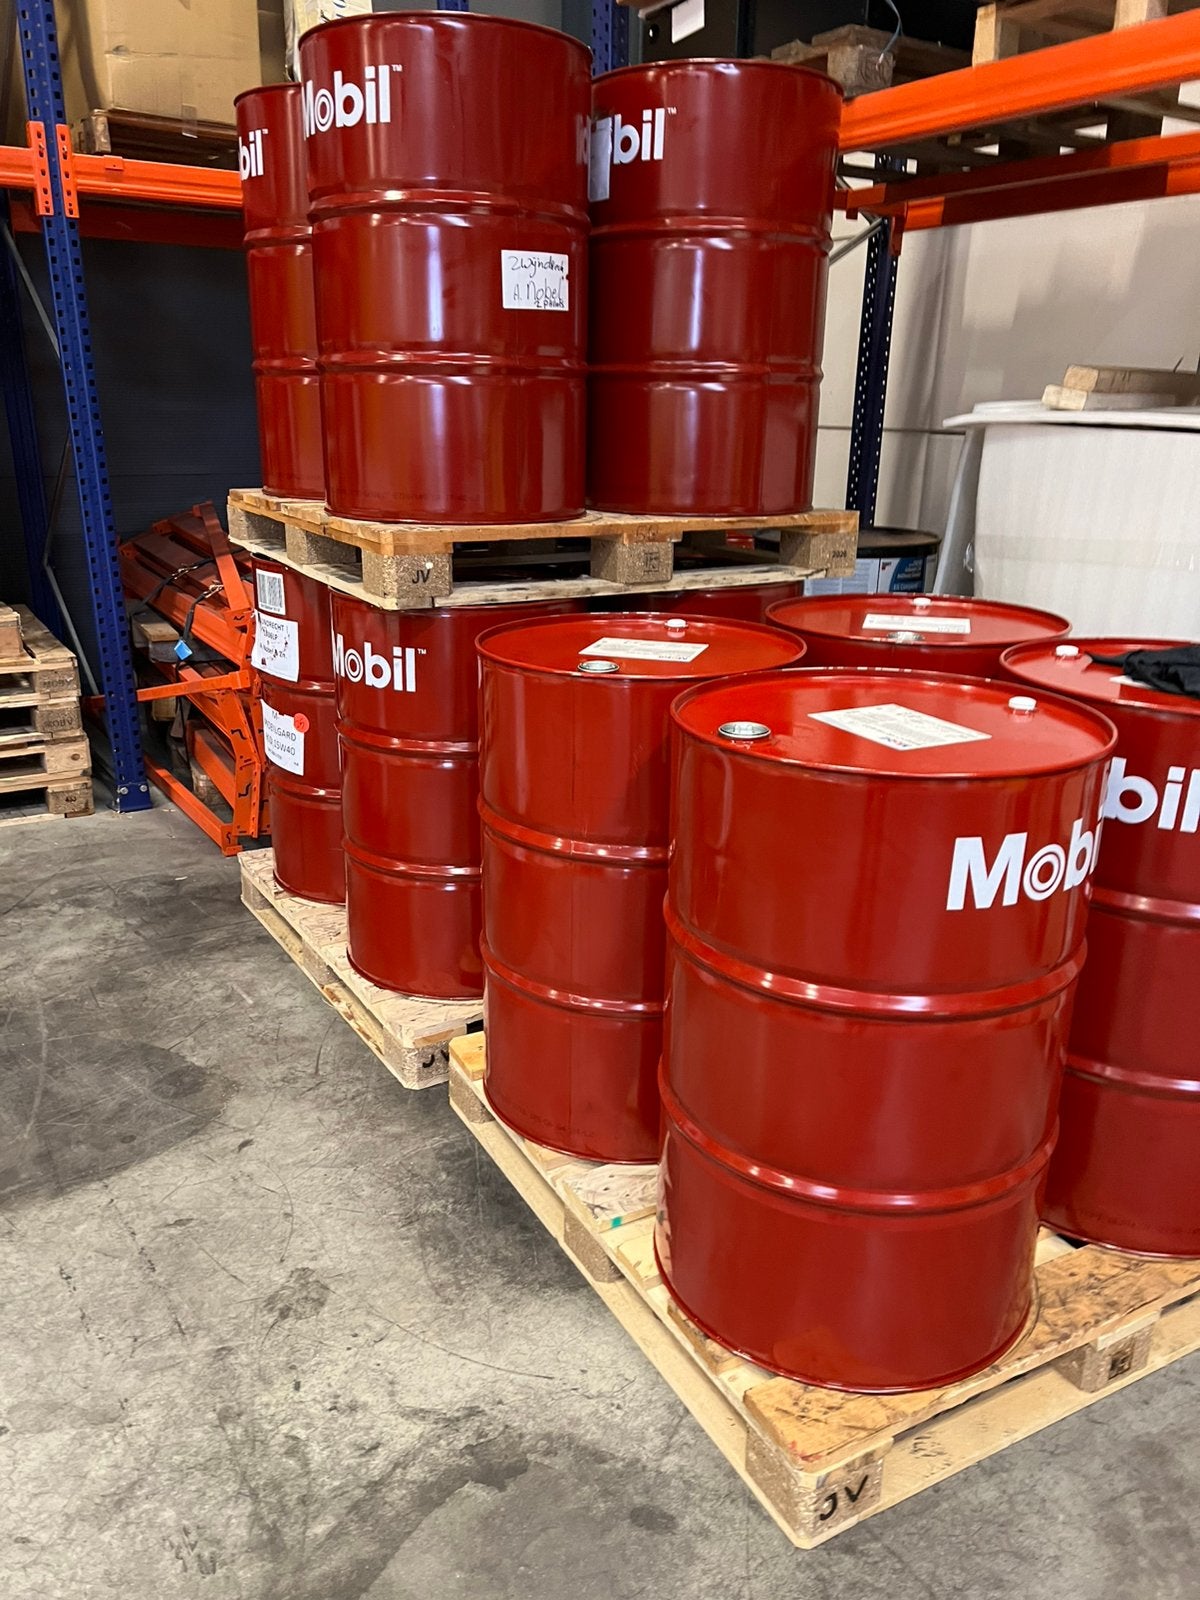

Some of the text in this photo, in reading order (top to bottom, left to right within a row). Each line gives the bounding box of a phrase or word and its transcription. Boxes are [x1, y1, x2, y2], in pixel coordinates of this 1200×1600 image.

[301, 64, 391, 141] Mobil
[526, 278, 562, 301] Nobel
[411, 569, 431, 584] JV
[331, 629, 416, 692] Mobil
[819, 1475, 869, 1521] JV
